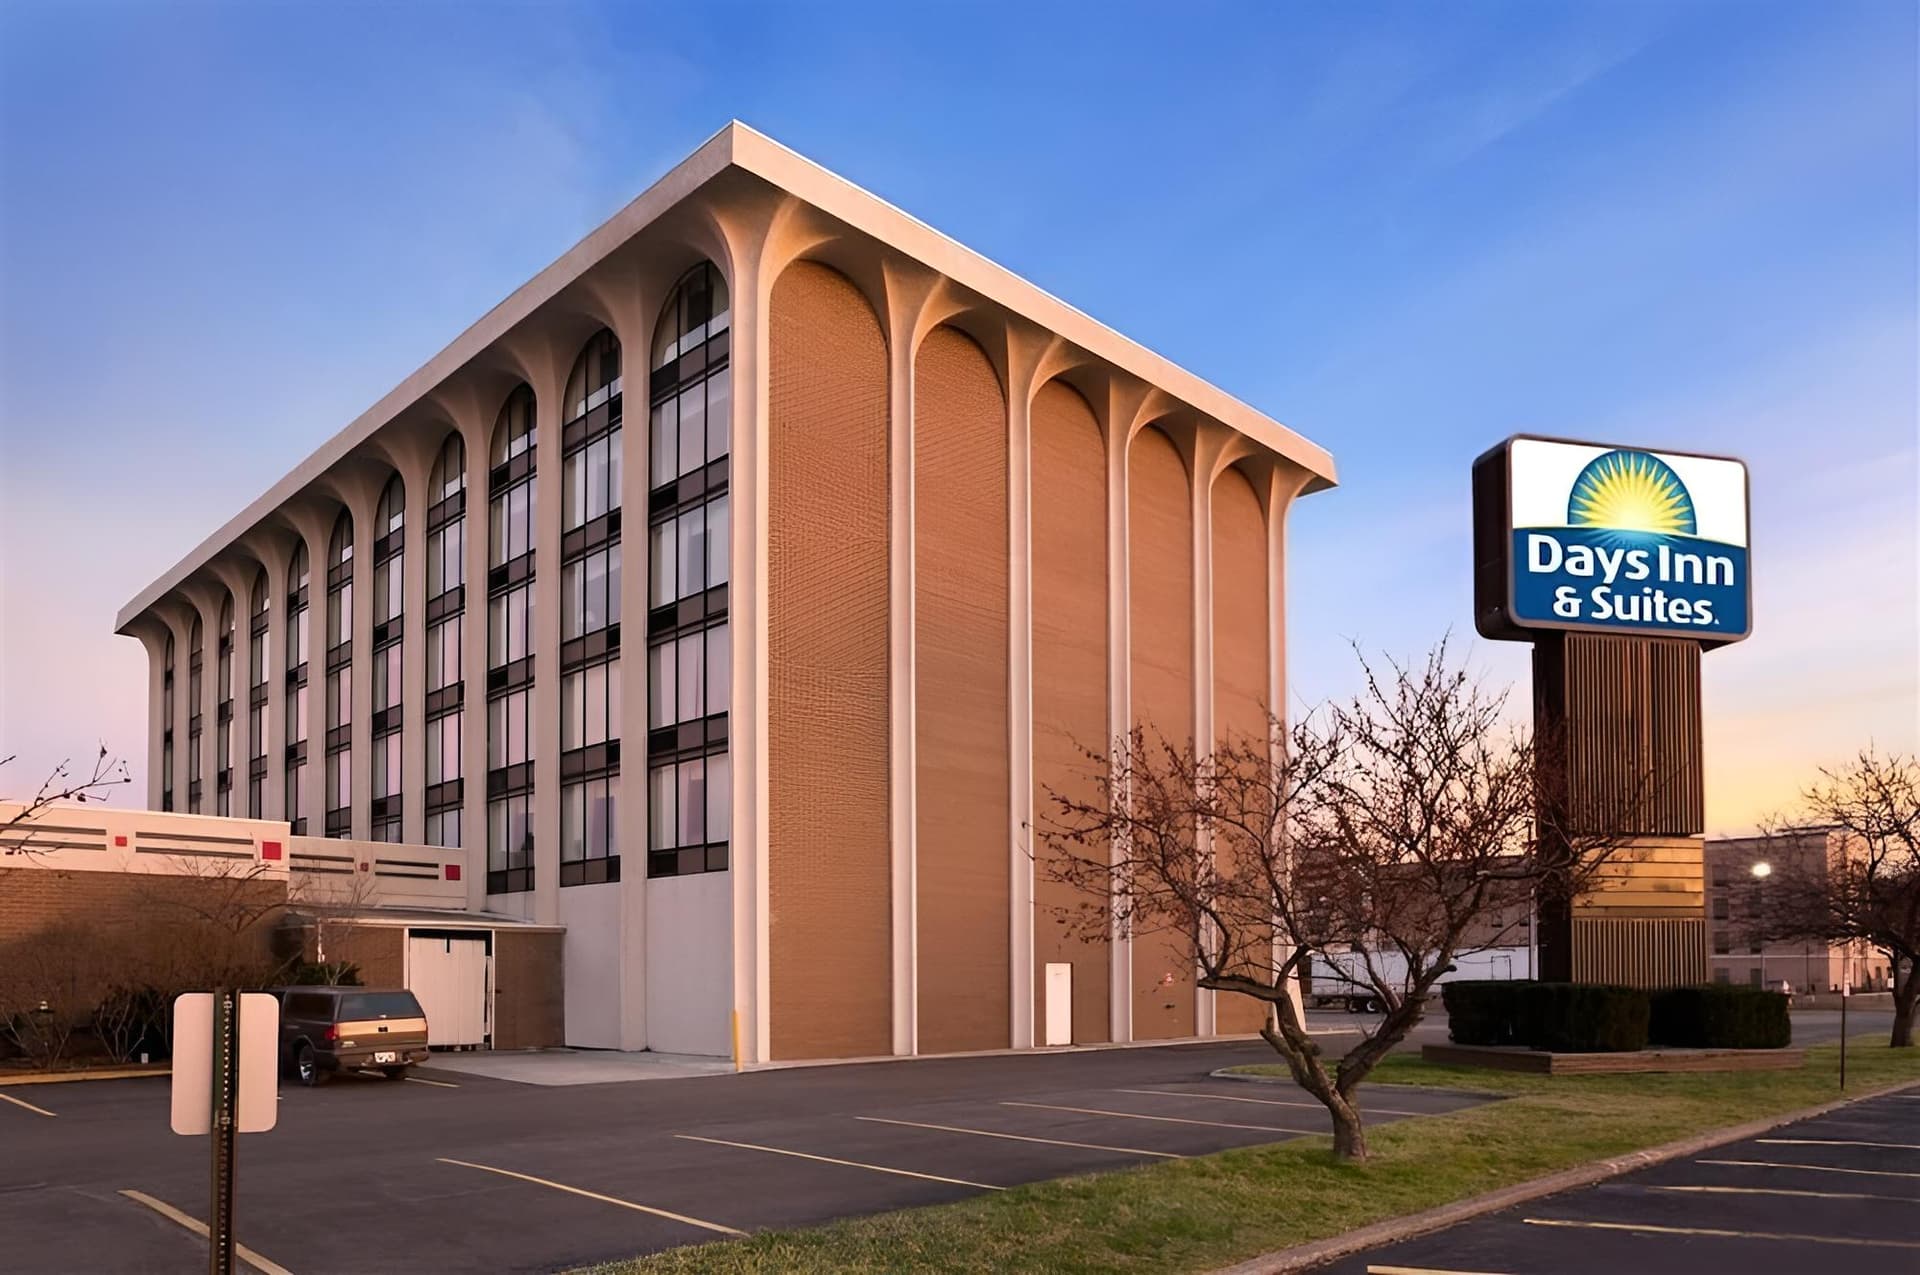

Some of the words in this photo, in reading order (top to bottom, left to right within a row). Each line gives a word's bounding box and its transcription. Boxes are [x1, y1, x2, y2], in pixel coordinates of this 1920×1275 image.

[1528, 534, 1649, 583] Days
[1658, 545, 1734, 586] Inn
[1553, 586, 1583, 618] &
